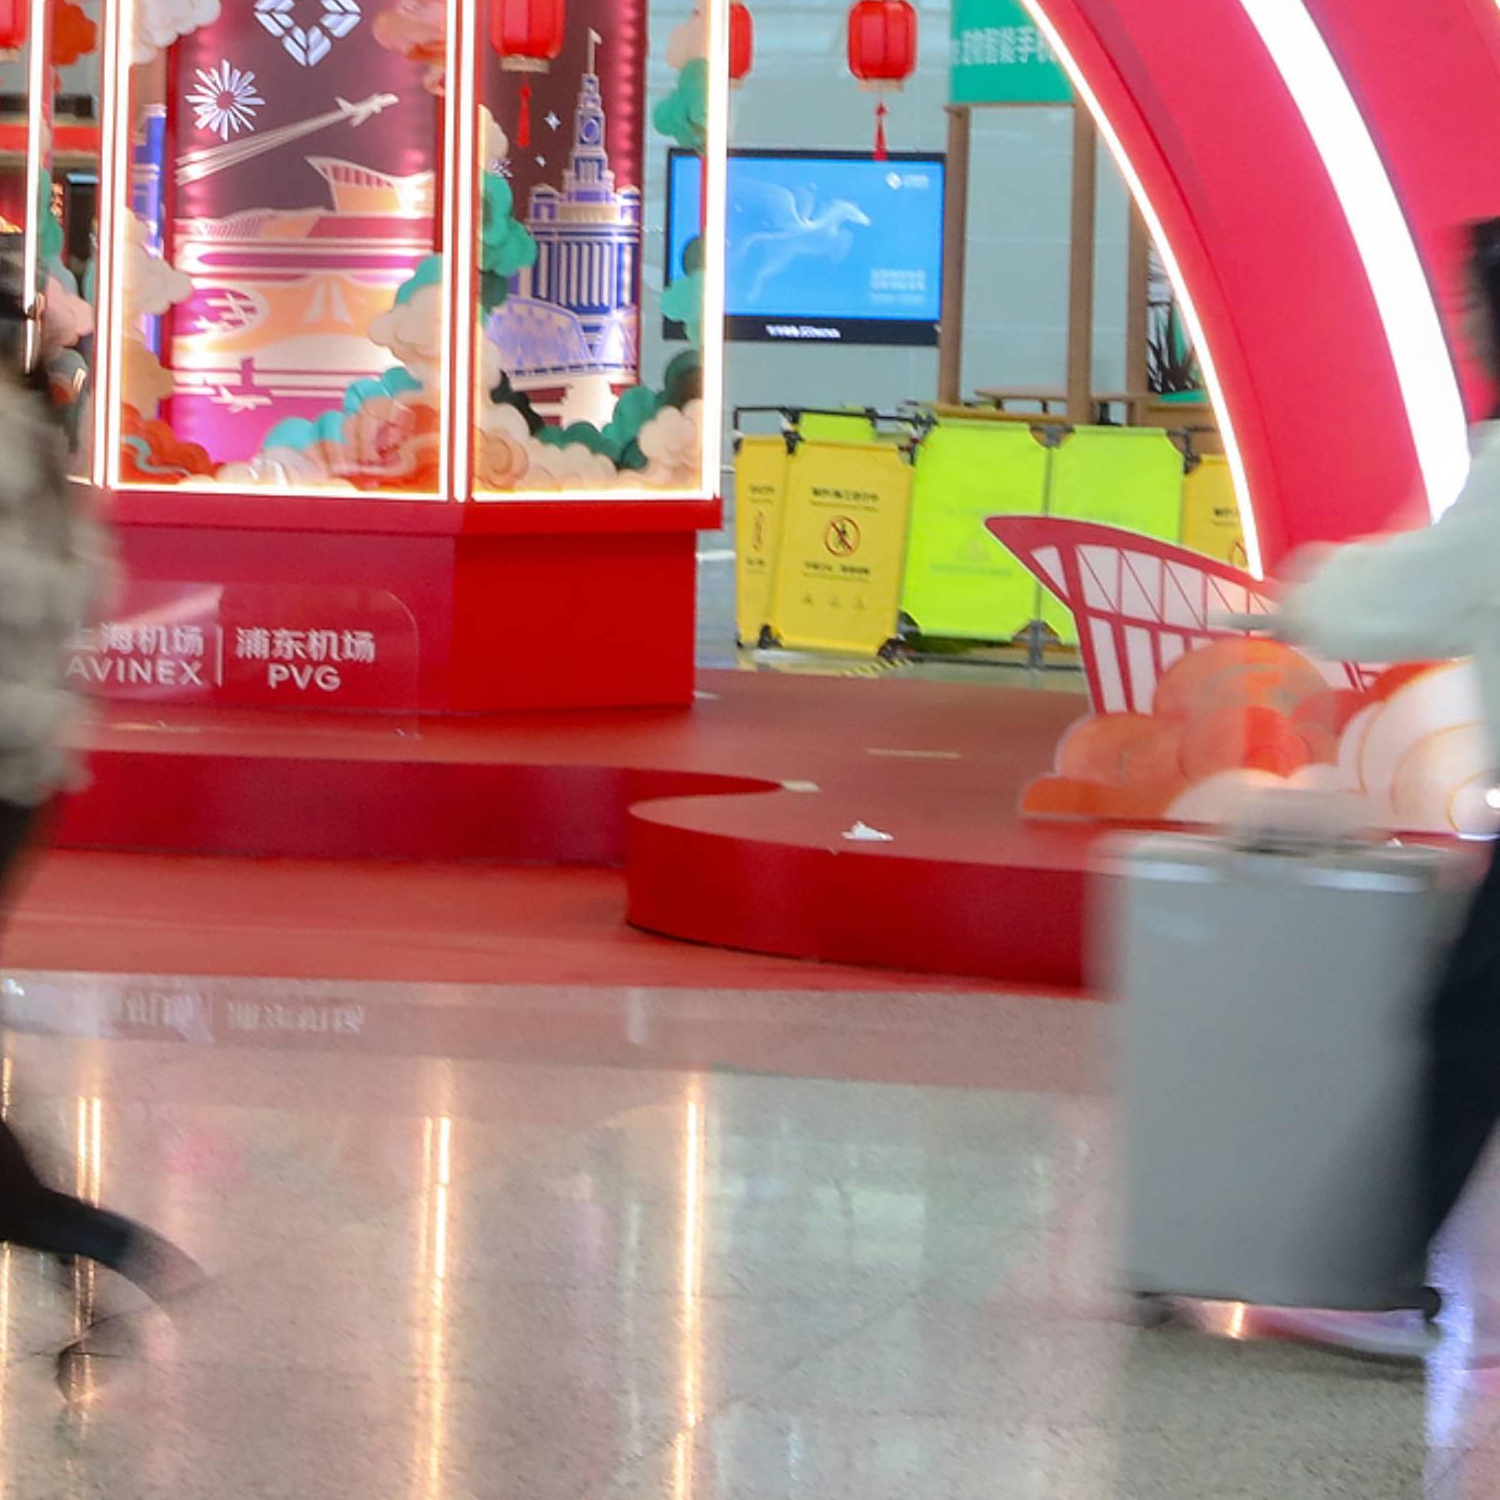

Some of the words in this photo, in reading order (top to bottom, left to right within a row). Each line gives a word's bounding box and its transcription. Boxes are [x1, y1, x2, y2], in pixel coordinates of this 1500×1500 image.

[235, 626, 376, 663] 浦东机场
[65, 656, 204, 686] AVINEX
[266, 662, 342, 692] PVG
